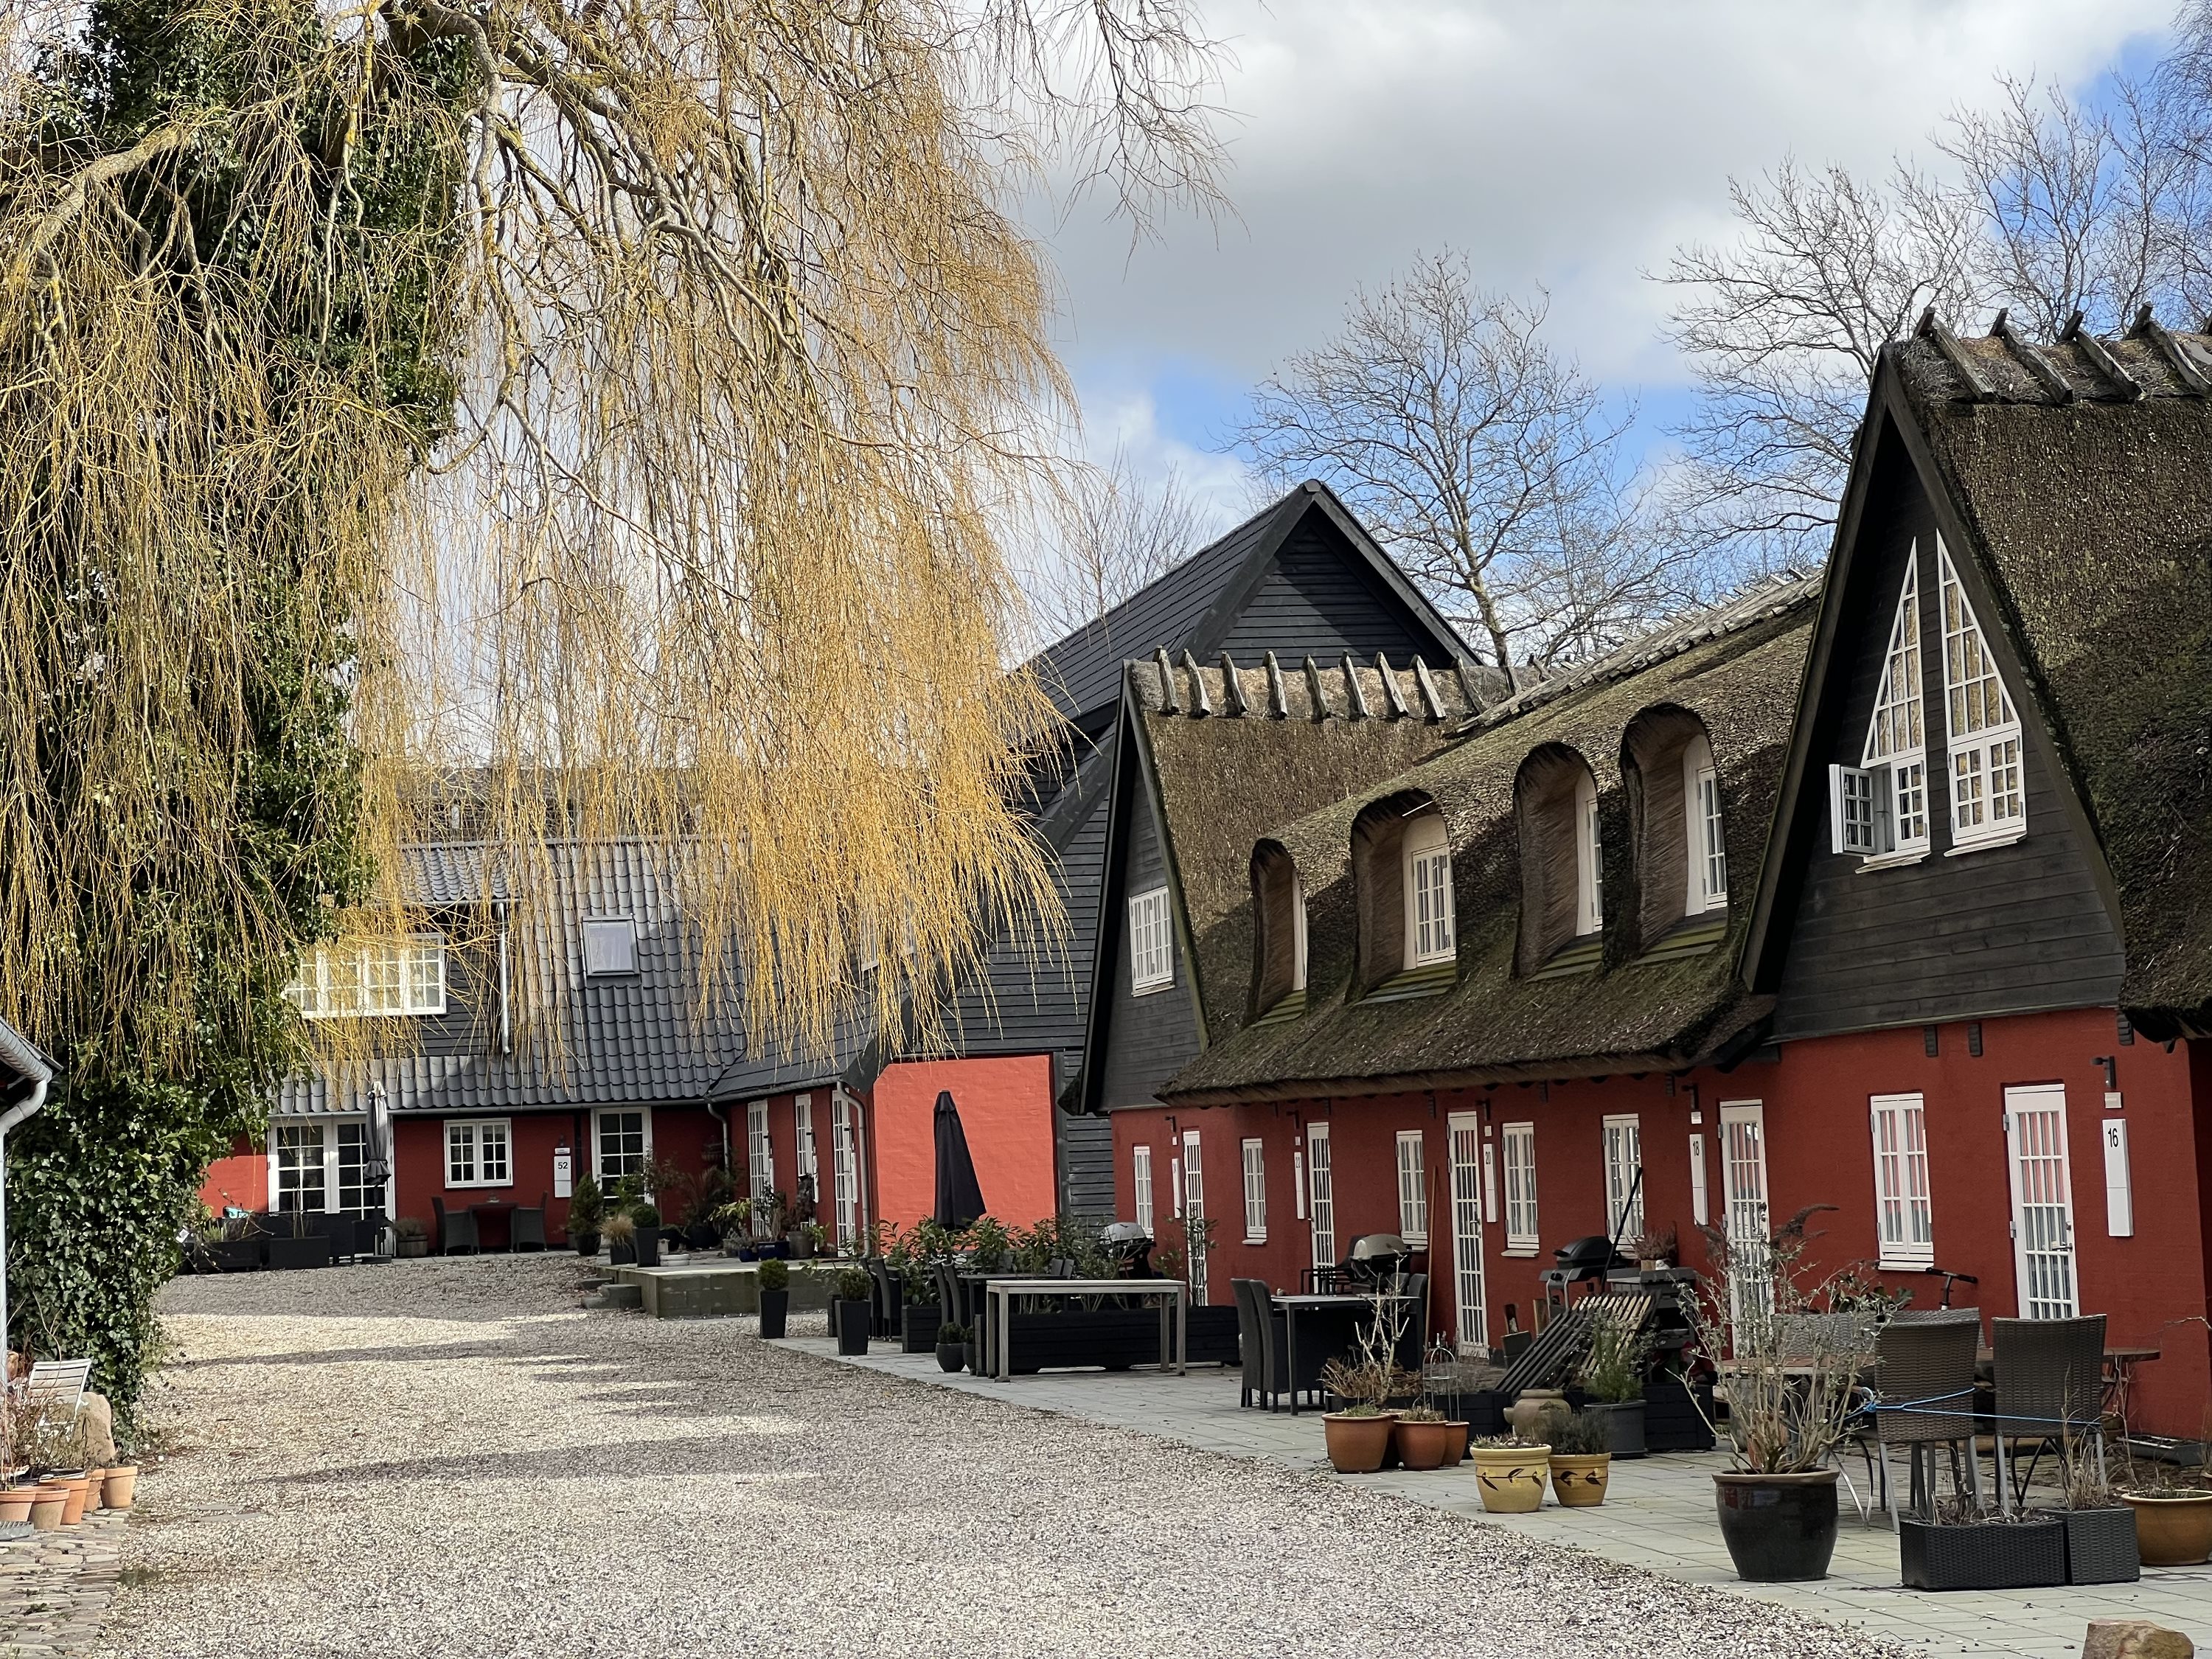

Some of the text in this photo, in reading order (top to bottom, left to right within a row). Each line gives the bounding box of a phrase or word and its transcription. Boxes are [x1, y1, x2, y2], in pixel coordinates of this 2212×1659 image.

[2108, 1127, 2118, 1147] 16
[1693, 1141, 1700, 1156] 18
[557, 1161, 568, 1169] 52
